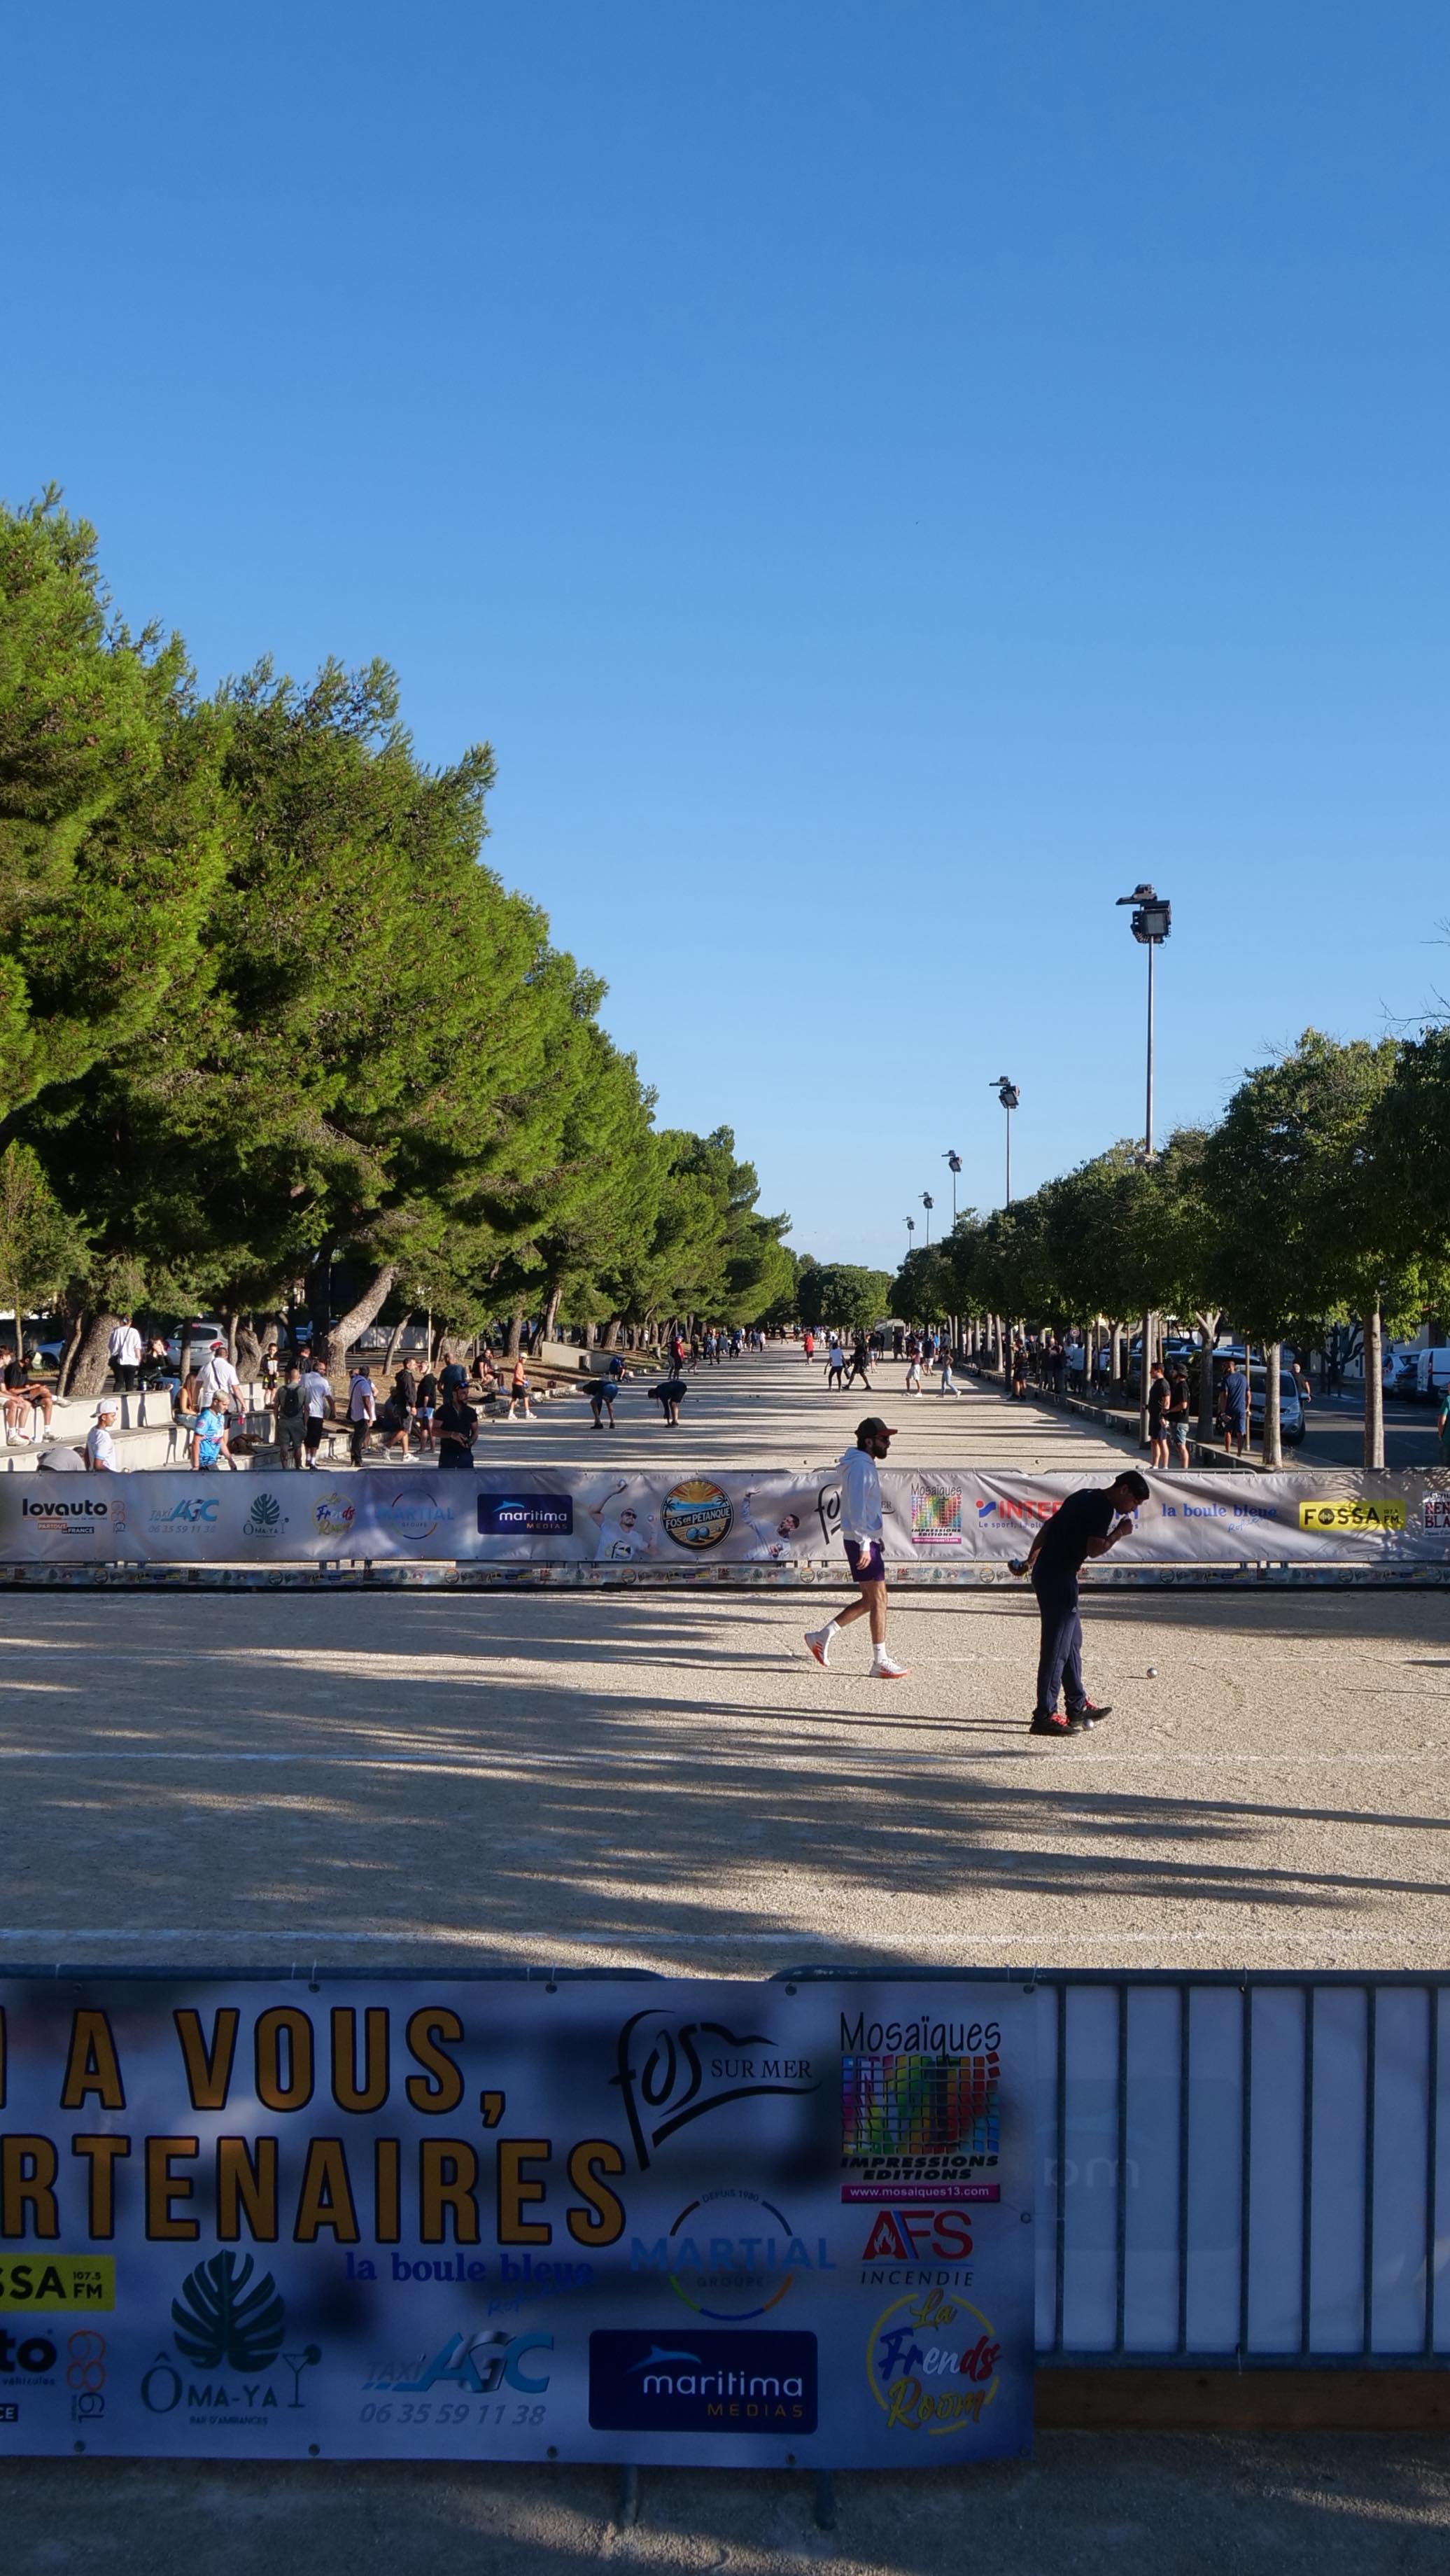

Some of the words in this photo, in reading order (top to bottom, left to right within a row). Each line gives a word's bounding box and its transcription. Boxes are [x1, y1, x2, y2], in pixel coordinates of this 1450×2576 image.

[22, 1498, 107, 1516] lovauto
[499, 1510, 568, 1521] maritima
[1162, 1504, 1176, 1517] la
[1183, 1504, 1226, 1518] boule
[1234, 1504, 1277, 1518] bleue
[840, 2011, 1001, 2066] Mosaïques
[60, 2008, 127, 2110] A
[173, 2005, 506, 2128] VOUS,
[711, 2059, 755, 2078] SUR
[761, 2060, 812, 2079] MER
[840, 2155, 999, 2169] IMPRESSIONS
[863, 2169, 971, 2180] EDITIONS
[0, 2133, 626, 2248] RTENAIRES
[702, 2189, 735, 2203] DEPUIS
[850, 2186, 990, 2200] www.mosaiques13.com
[862, 2210, 973, 2260] AFS
[631, 2237, 837, 2272] MARTIAL
[73, 2271, 101, 2281] 107.5
[345, 2252, 377, 2281] la
[391, 2252, 486, 2282] boule
[500, 2253, 594, 2283] bleue
[0, 2265, 66, 2300] SA
[696, 2276, 763, 2288] GROUPE
[861, 2271, 974, 2287] INCENDIE
[73, 2283, 101, 2300] FM
[879, 2327, 1002, 2382] Frends
[643, 2370, 803, 2397] maritima
[708, 2403, 803, 2418] MEDIAS
[887, 2376, 985, 2430] Room
[360, 2402, 393, 2423] 06
[397, 2402, 431, 2424] 35
[435, 2403, 469, 2424] 59
[479, 2404, 506, 2425] 11
[512, 2404, 546, 2426] 38
